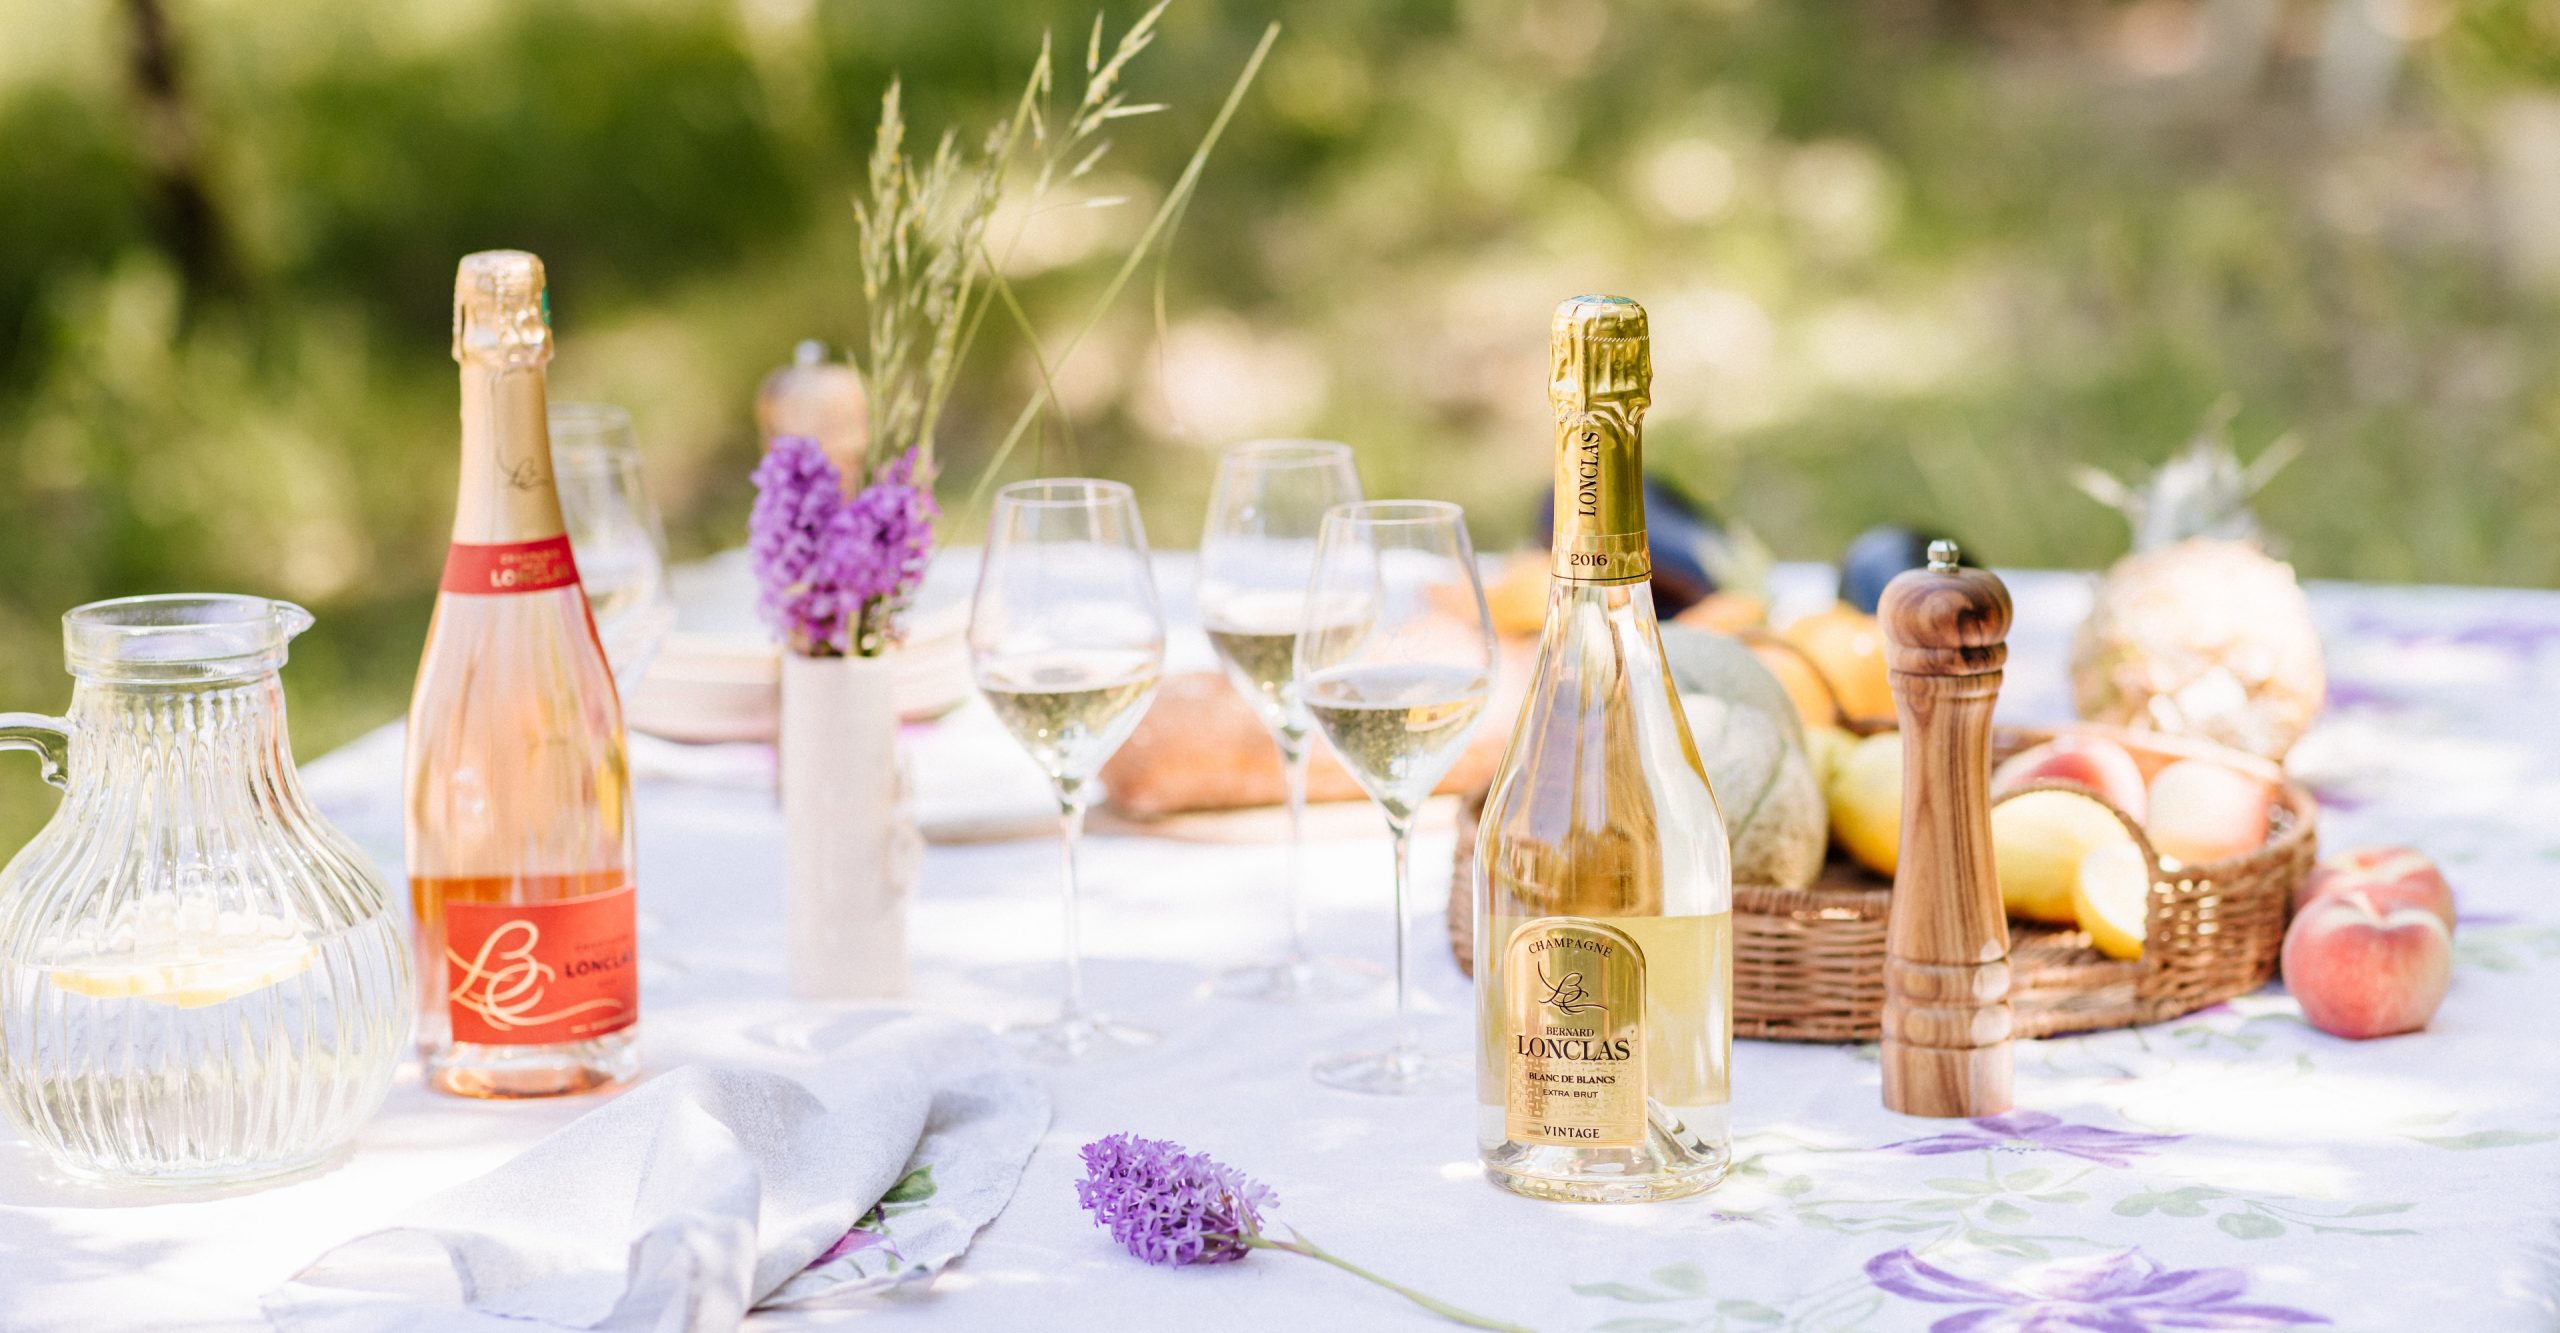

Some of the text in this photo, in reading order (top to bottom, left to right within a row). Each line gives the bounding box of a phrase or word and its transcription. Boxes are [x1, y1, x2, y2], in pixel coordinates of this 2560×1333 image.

[1578, 432, 1600, 517] LONCLAS
[1570, 552, 1608, 567] 2016
[1528, 937, 1613, 958] CHAMPAGNE
[1546, 1026, 1595, 1037] BERNARD
[1516, 1034, 1631, 1062] LONCLAS
[1528, 1072, 1616, 1085] BLANC DE BLANCS
[1542, 1088, 1598, 1099] EXTRA BRUT
[1543, 1125, 1600, 1139] VINTAGE
